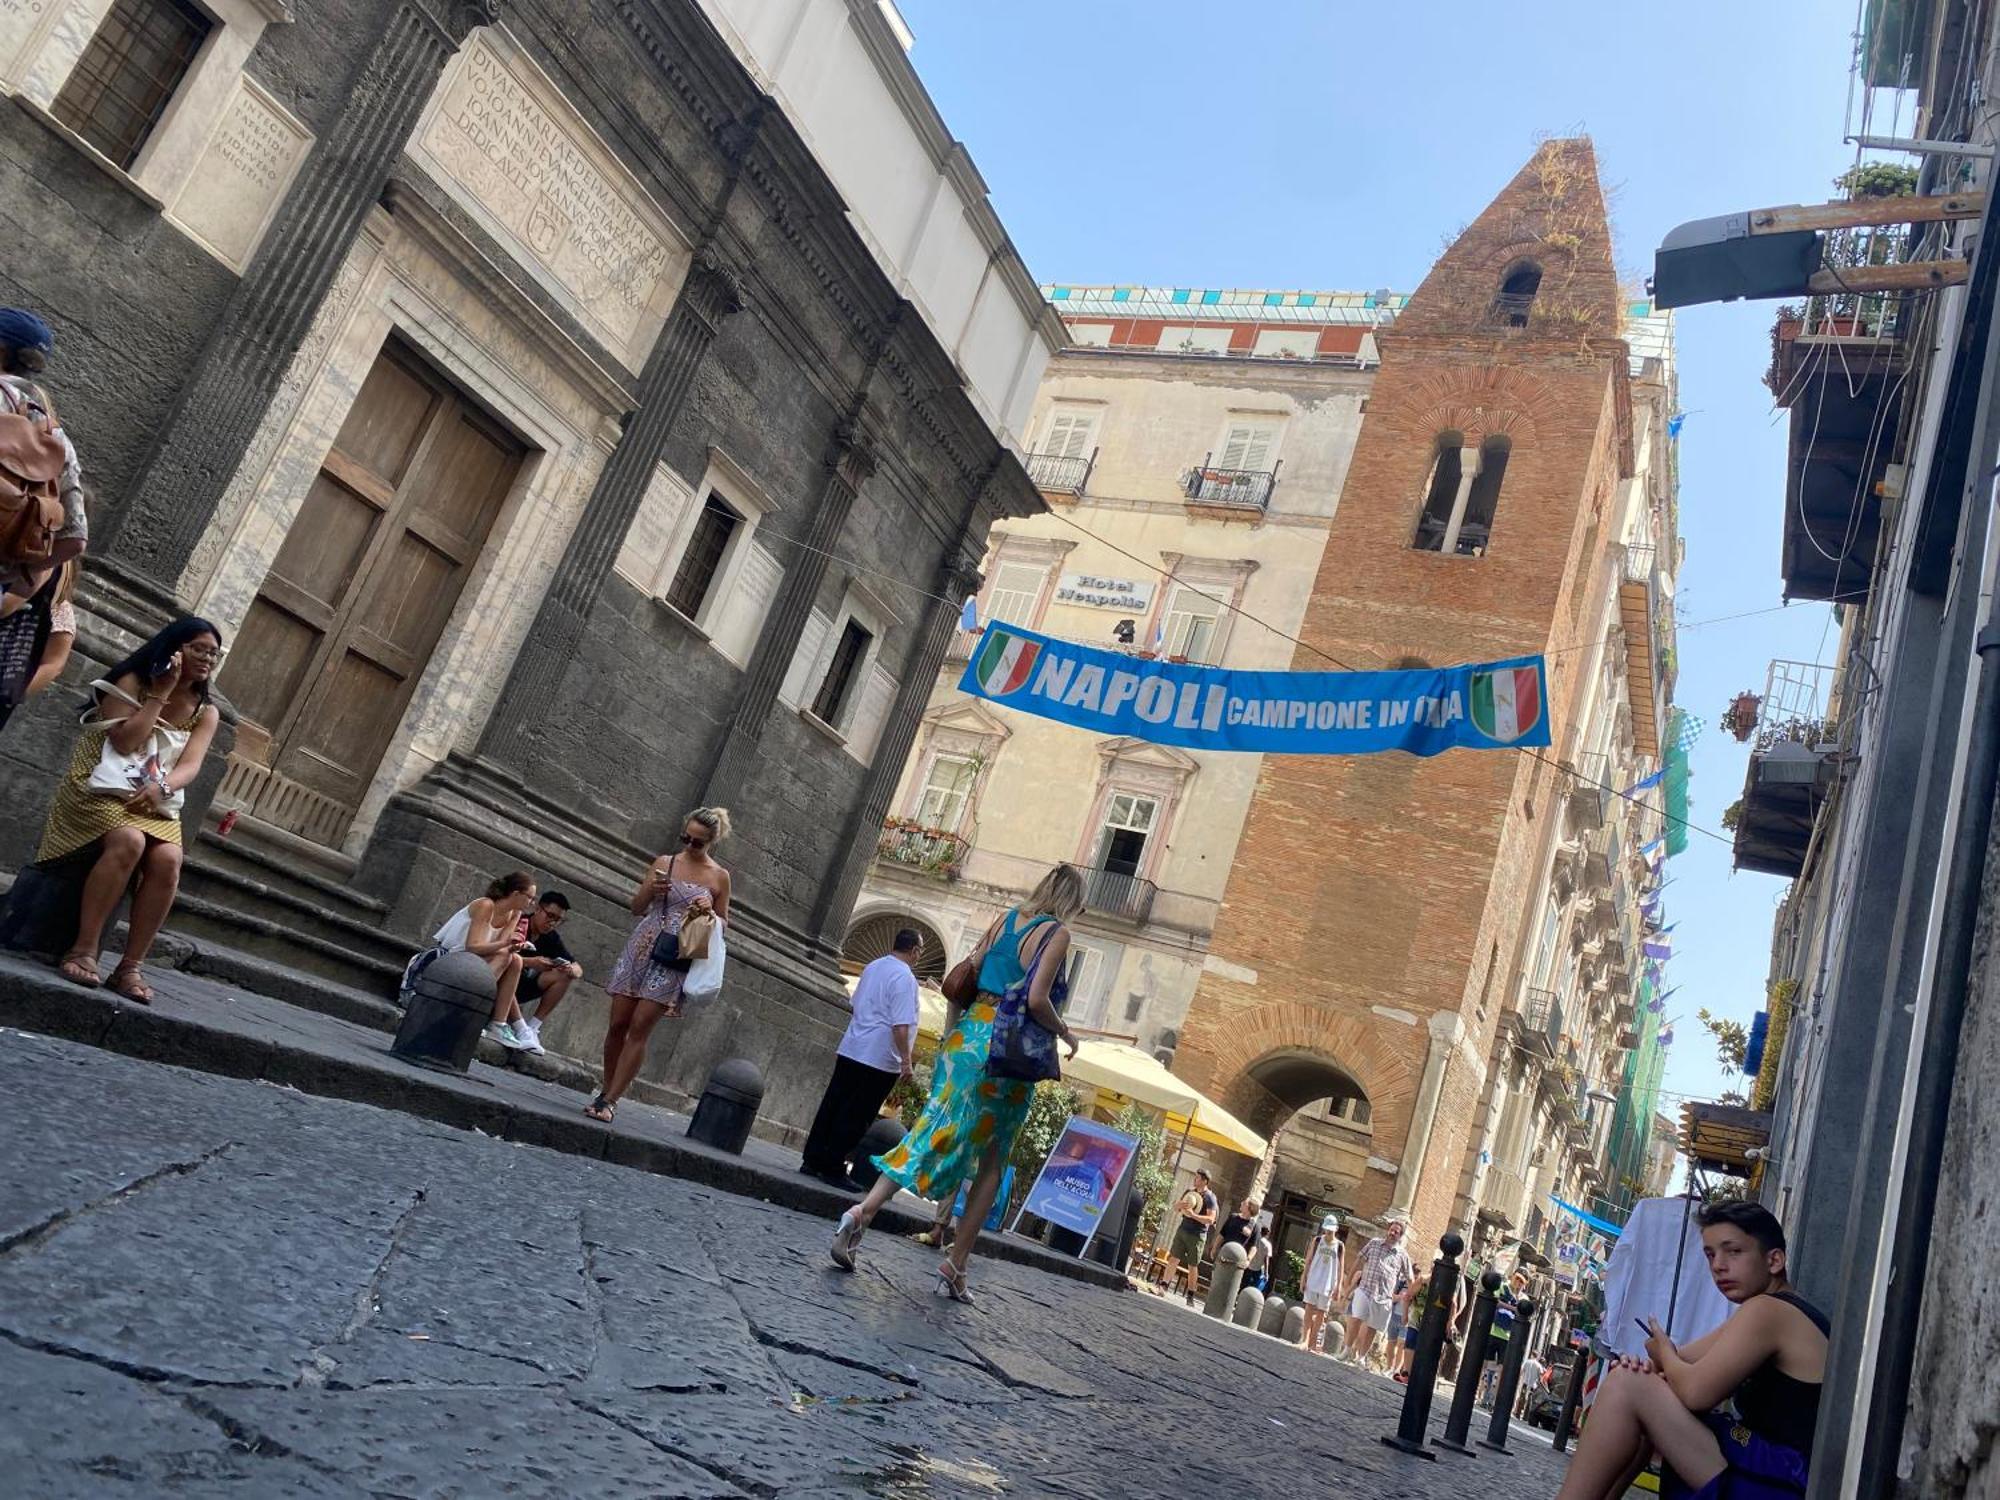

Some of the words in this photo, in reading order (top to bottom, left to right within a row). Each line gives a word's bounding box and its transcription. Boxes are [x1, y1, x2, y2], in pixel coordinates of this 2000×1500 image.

[473, 48, 515, 98] DIVAE
[518, 98, 577, 165] MARIAE
[1058, 588, 1146, 609] Neapolis
[1077, 575, 1134, 592] Hotel
[1031, 653, 1227, 732] NAPOLI
[1227, 697, 1372, 730] CAMPIONE
[1379, 700, 1410, 726] IN
